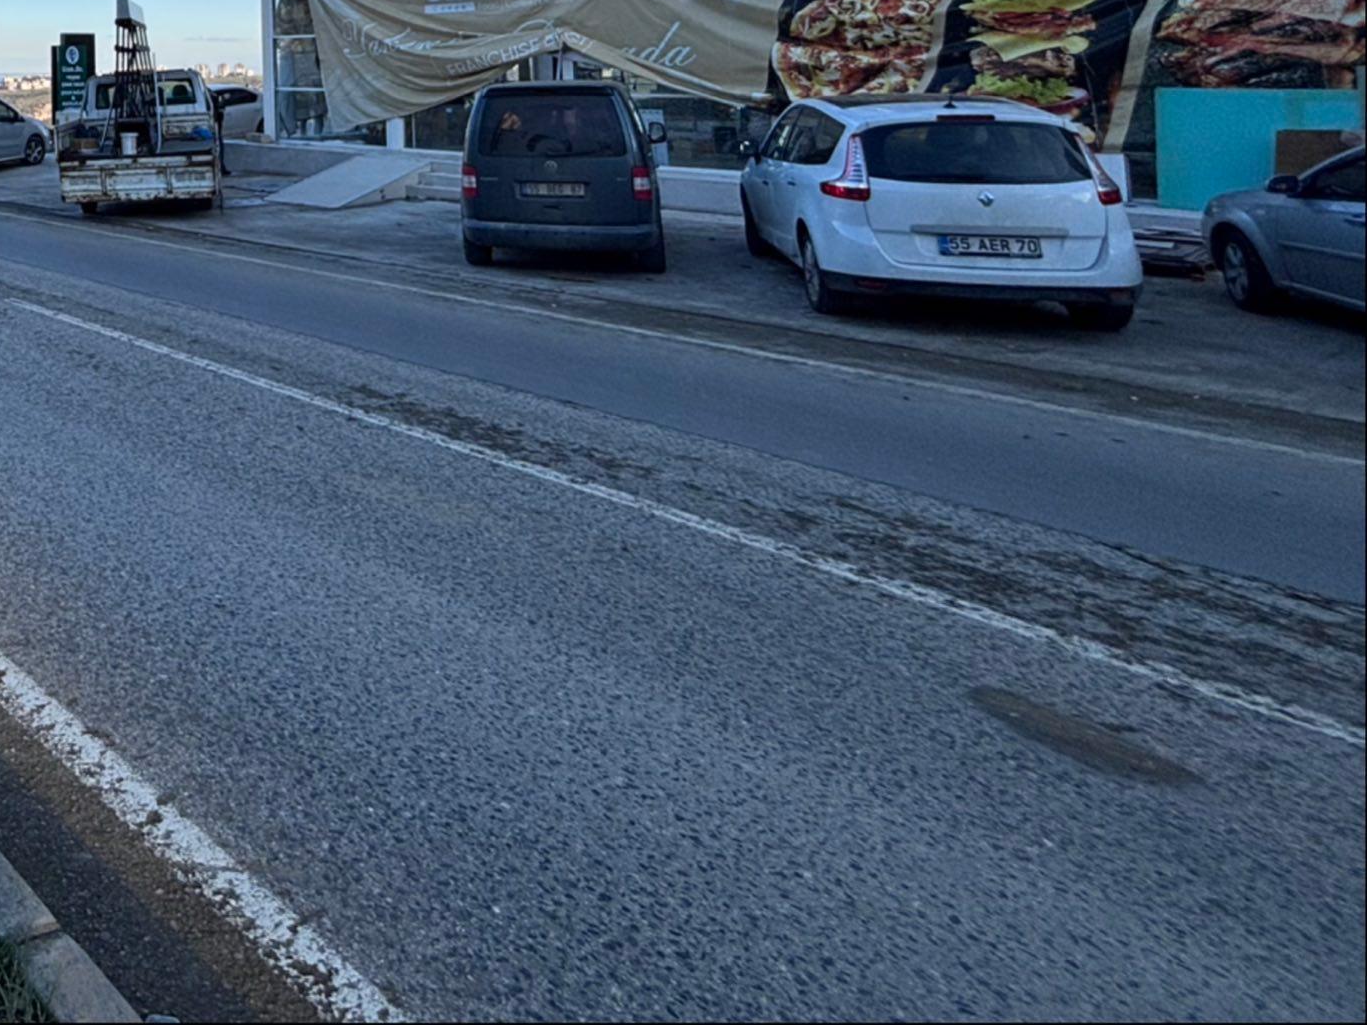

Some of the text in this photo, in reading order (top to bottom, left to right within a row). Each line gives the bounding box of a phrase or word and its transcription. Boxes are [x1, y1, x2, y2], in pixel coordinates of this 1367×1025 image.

[445, 37, 540, 75] FRANCHISE
[949, 236, 1039, 253] 55 AER 70
